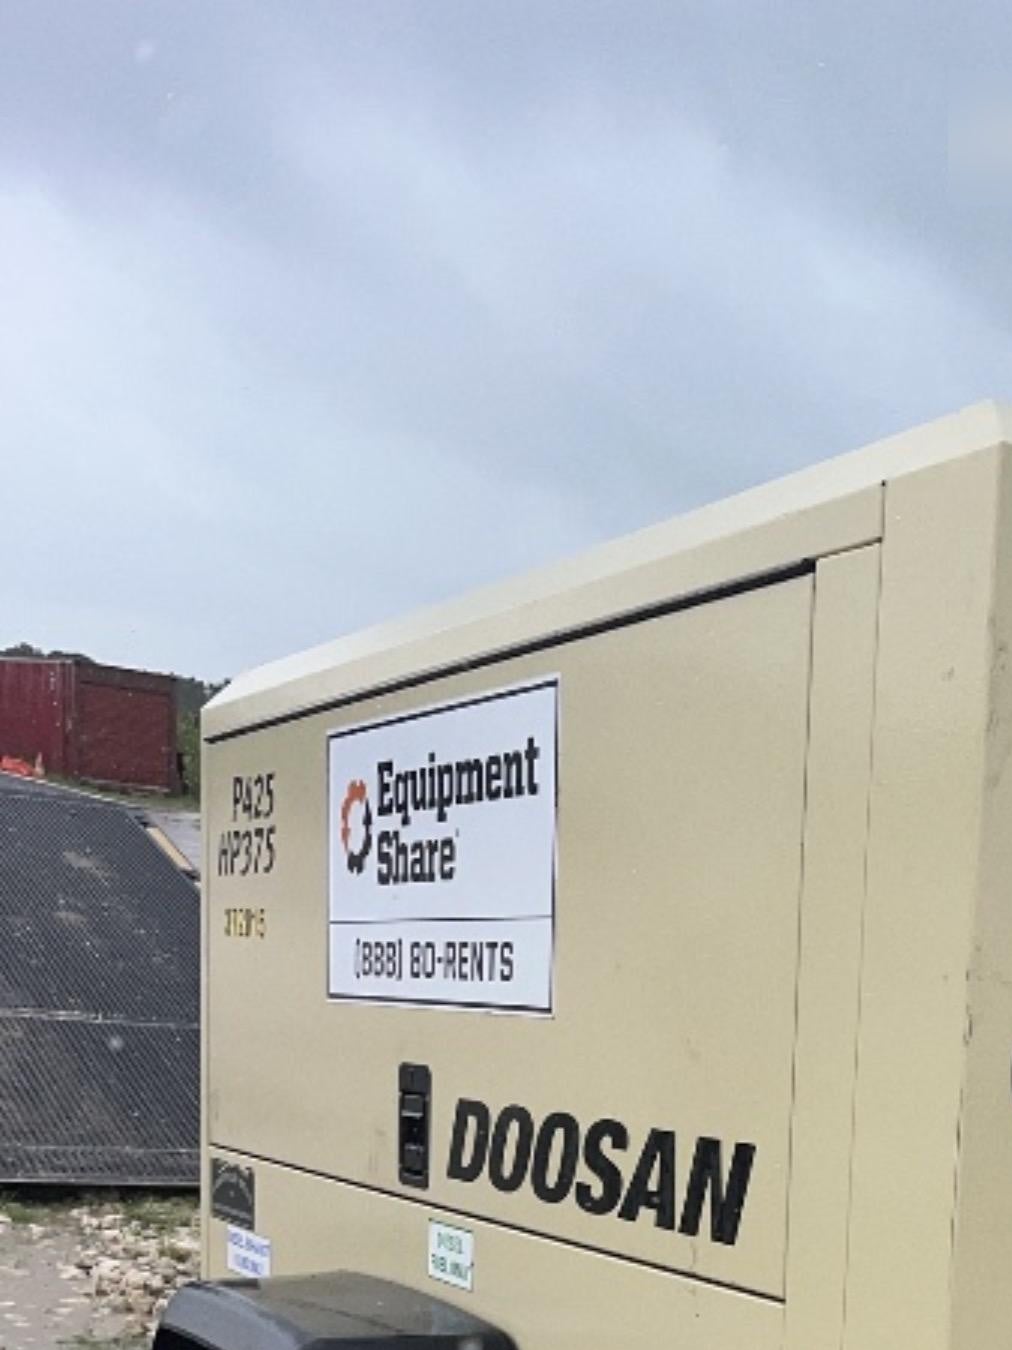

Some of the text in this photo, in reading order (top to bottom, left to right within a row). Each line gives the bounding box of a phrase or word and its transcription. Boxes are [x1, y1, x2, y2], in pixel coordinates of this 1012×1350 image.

[232, 773, 275, 823] P425
[377, 737, 540, 825] Equipment
[218, 826, 276, 877] HP375
[377, 828, 457, 886] Share
[354, 938, 514, 982] (888) 80-RENTS
[446, 1097, 757, 1246] DOOSAN
